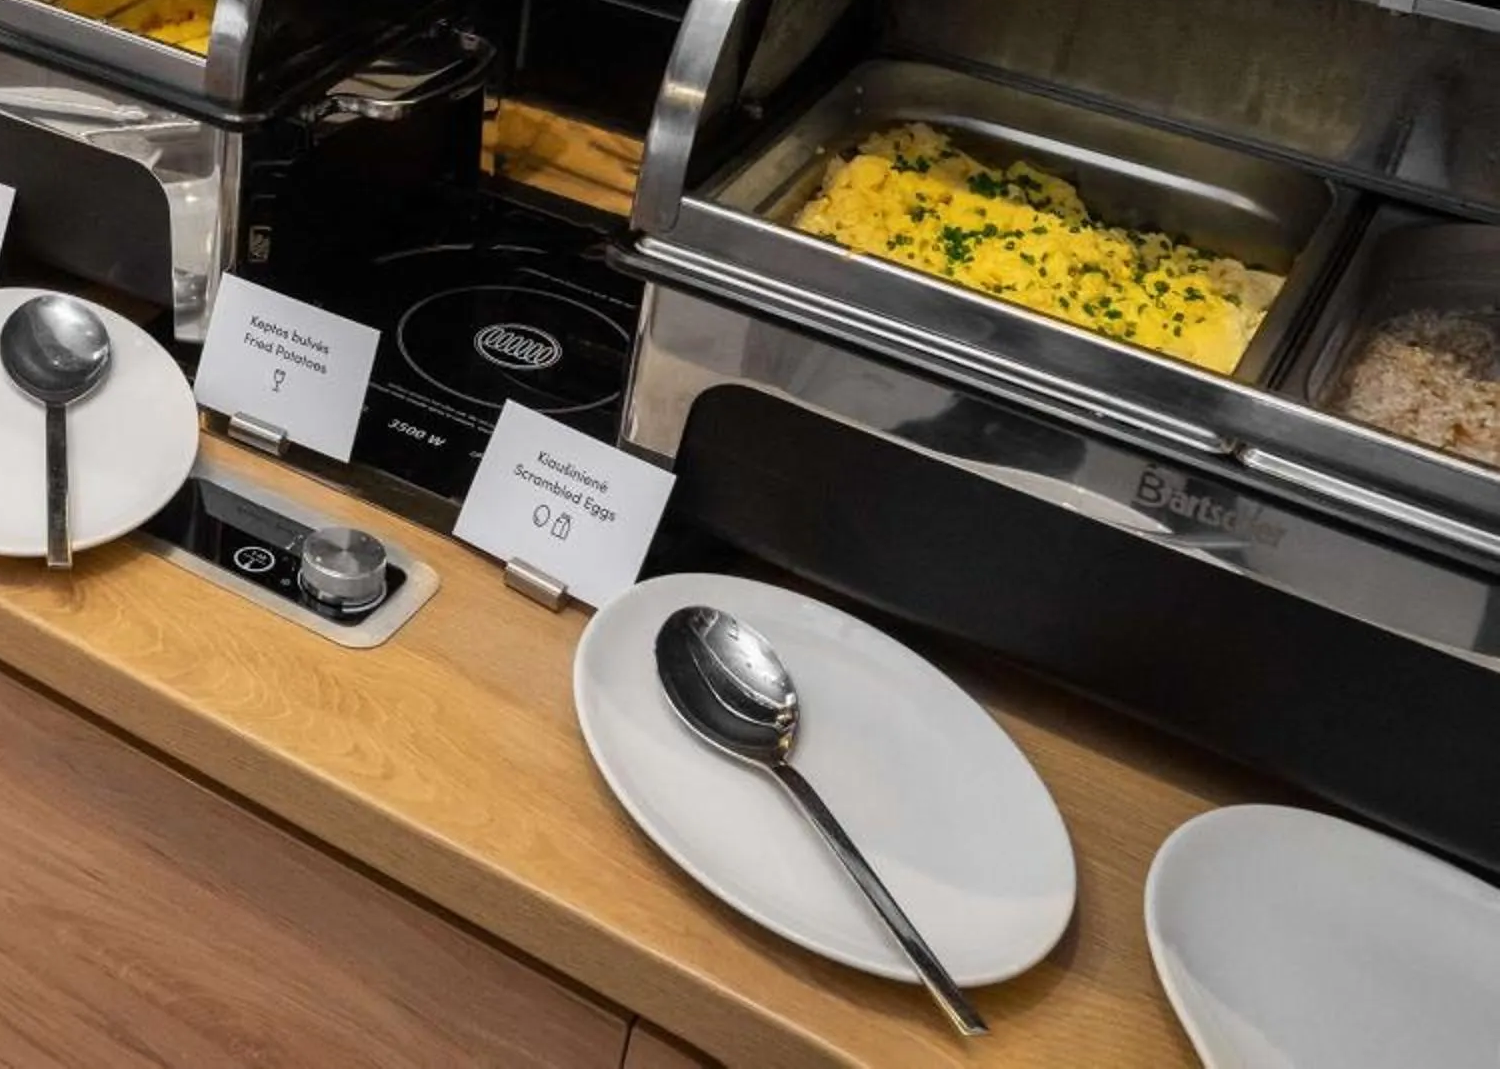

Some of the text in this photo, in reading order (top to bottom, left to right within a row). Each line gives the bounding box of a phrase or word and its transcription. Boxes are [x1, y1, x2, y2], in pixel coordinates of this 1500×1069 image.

[243, 332, 327, 374] Fried Potatoes
[387, 418, 447, 446] 3500 W
[514, 463, 616, 522] Scrambled Eggs
